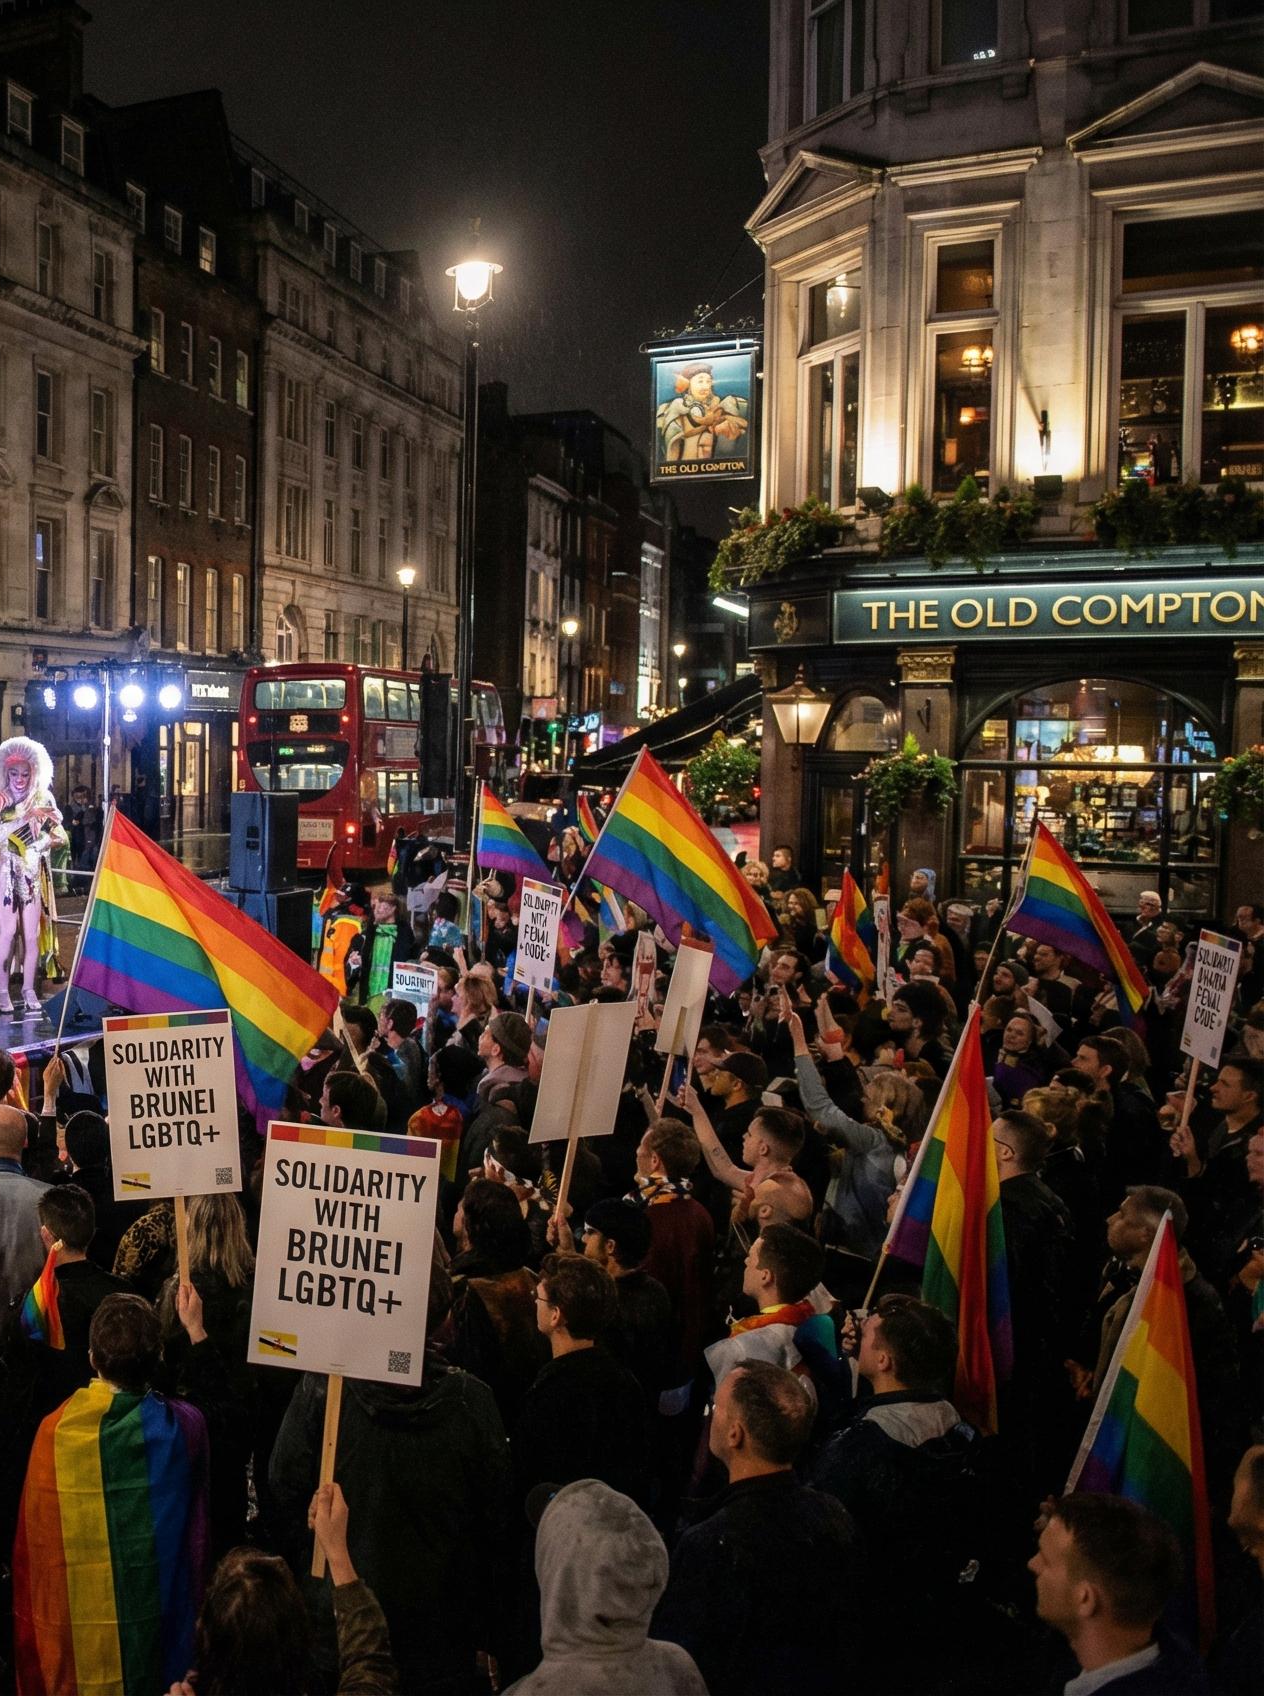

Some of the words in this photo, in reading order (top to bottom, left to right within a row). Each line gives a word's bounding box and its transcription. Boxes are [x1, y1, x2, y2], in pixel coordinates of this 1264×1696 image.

[660, 465, 677, 475] THE
[679, 464, 698, 473] OLD
[862, 600, 938, 629] THE
[951, 597, 1037, 627] OLD
[113, 1037, 224, 1064] SOLIDARITY
[145, 1065, 194, 1088] WITH
[131, 1089, 215, 1119] BRUNEI
[129, 1120, 220, 1149] LGBTQ+
[275, 1159, 426, 1203] SOLIDARITY
[315, 1198, 380, 1232] WITH
[287, 1228, 402, 1275] BRUNEI
[278, 1268, 402, 1316] LGBTQ+
